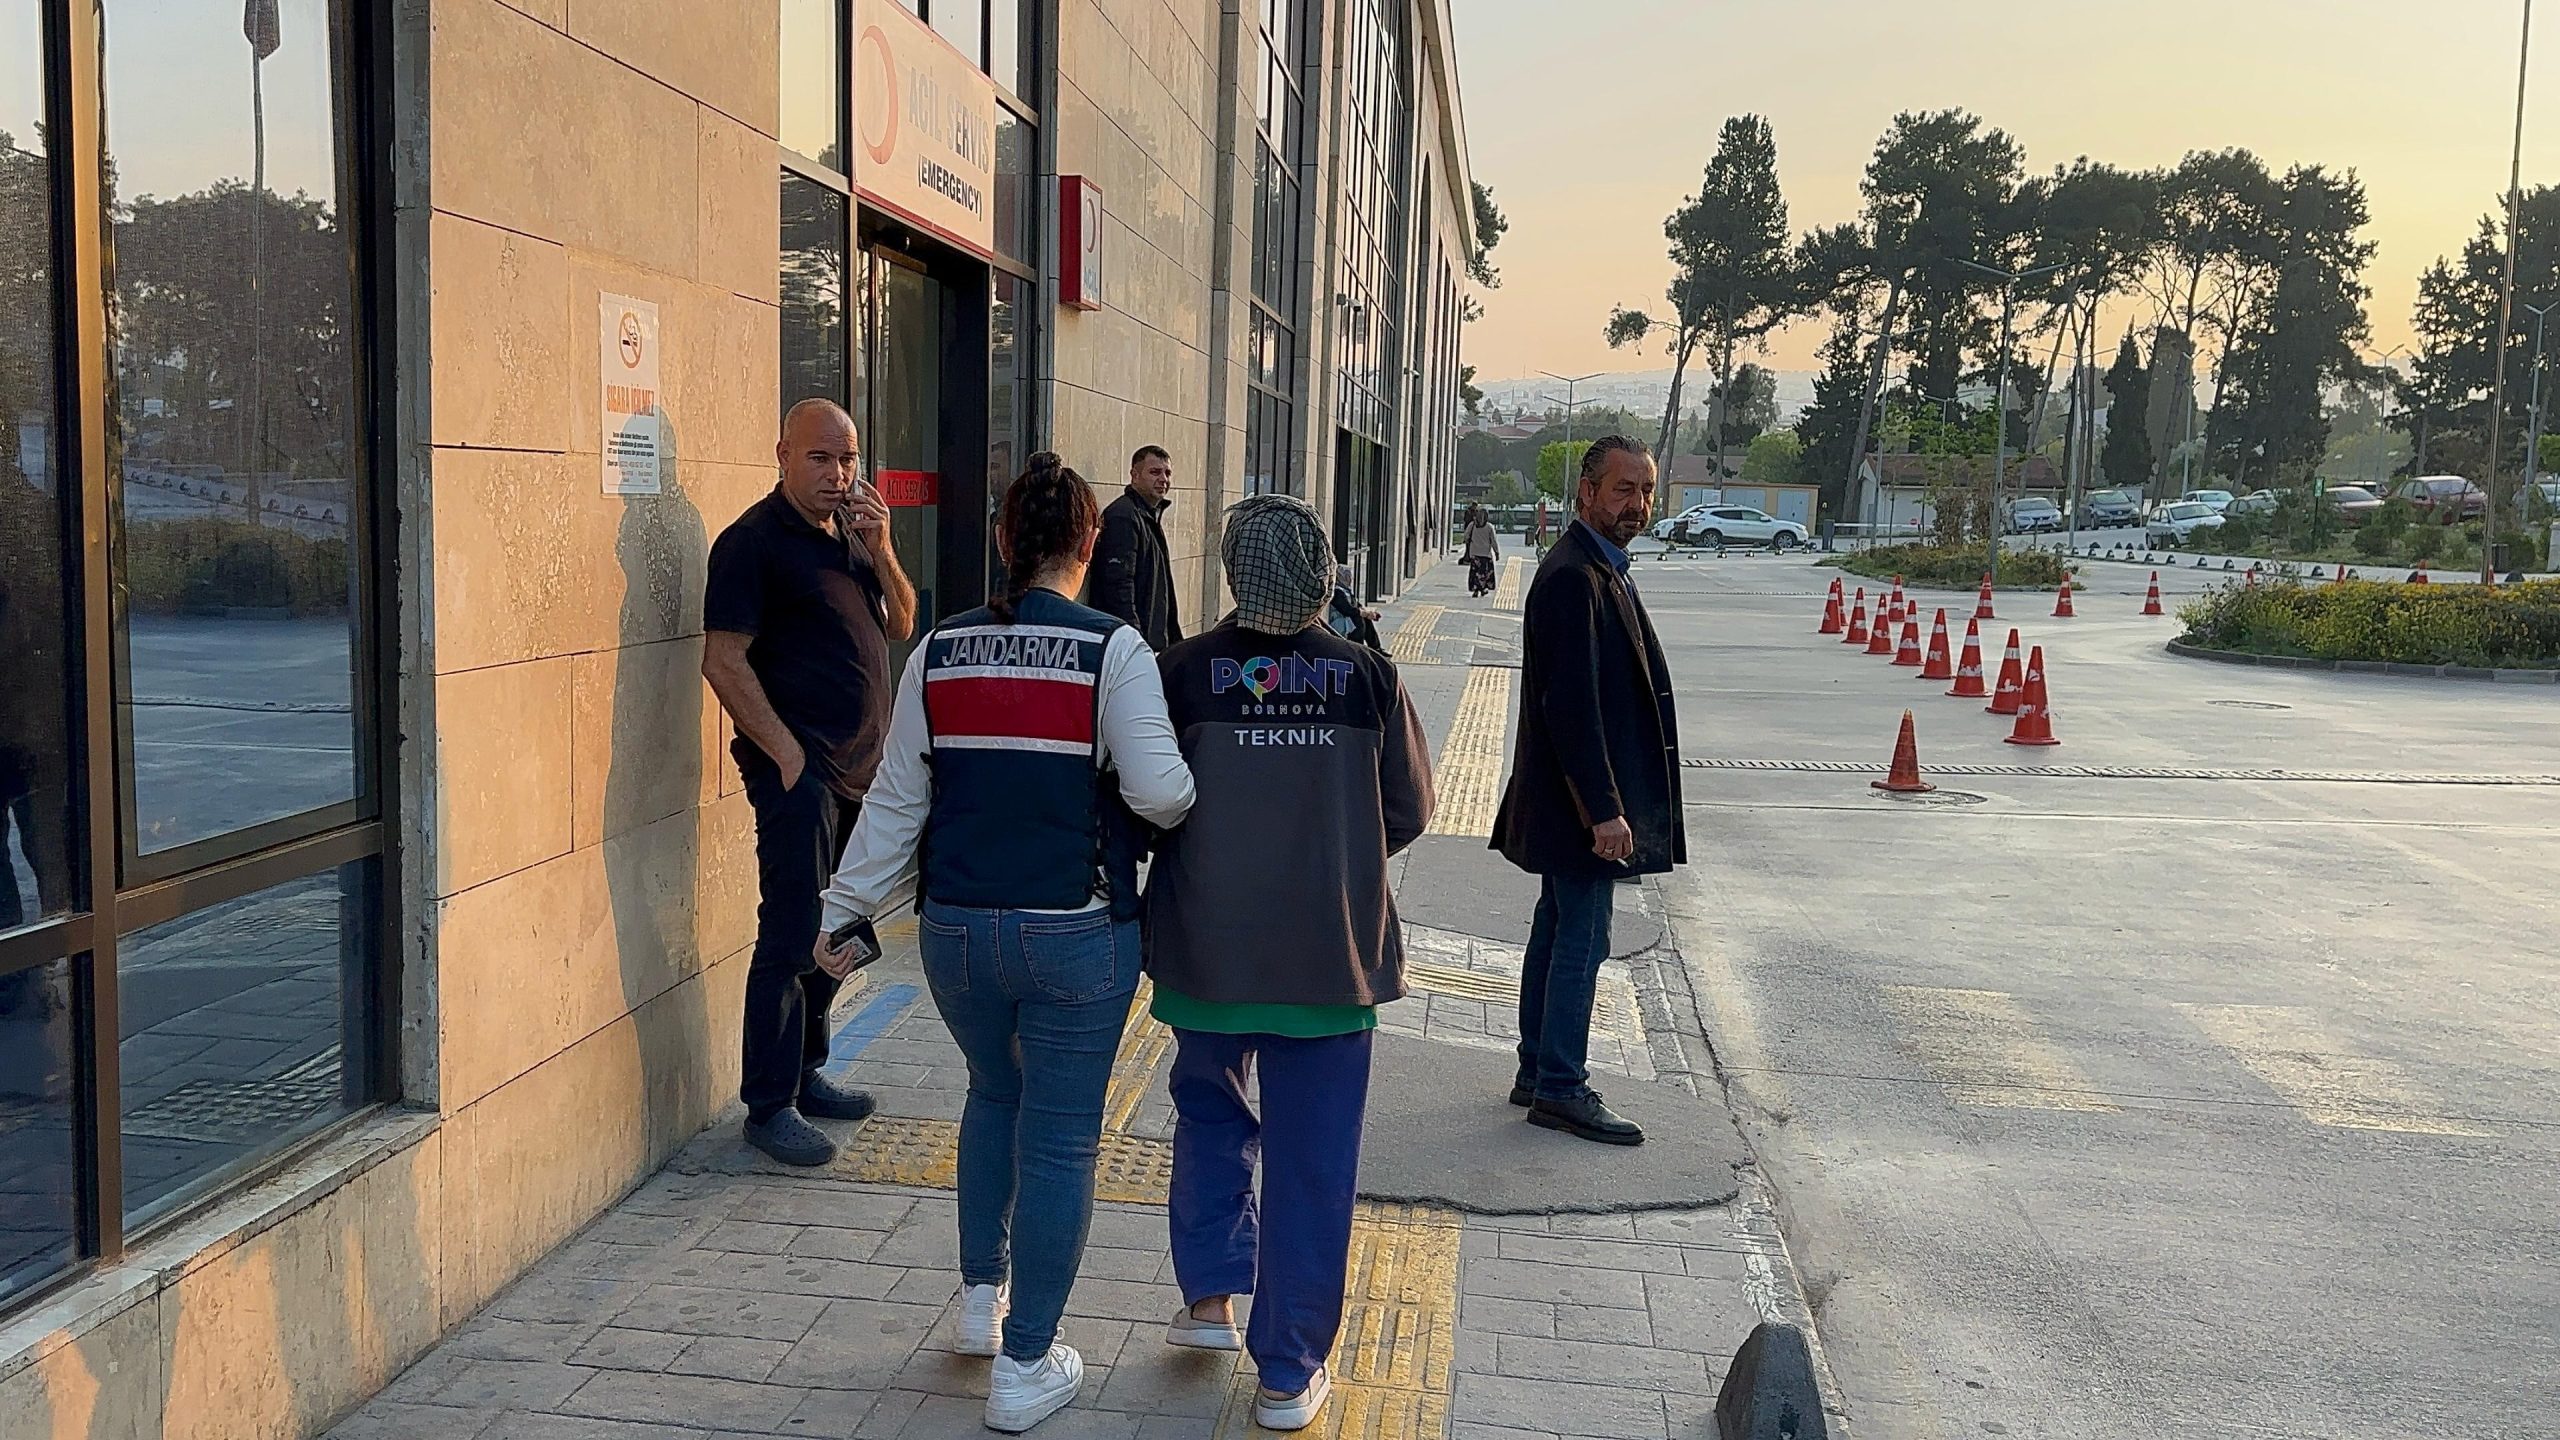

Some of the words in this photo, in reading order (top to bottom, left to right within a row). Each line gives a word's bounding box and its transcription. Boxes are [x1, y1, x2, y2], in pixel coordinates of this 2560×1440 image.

[908, 66, 942, 144] ACİL
[946, 93, 990, 175] SERVİS
[918, 153, 983, 222] (EMERGENCY)
[941, 635, 1080, 671] JANDARMA
[1211, 651, 1354, 702] POINT
[1241, 704, 1327, 716] BORNOVA
[1234, 724, 1336, 747] TEKNİK
